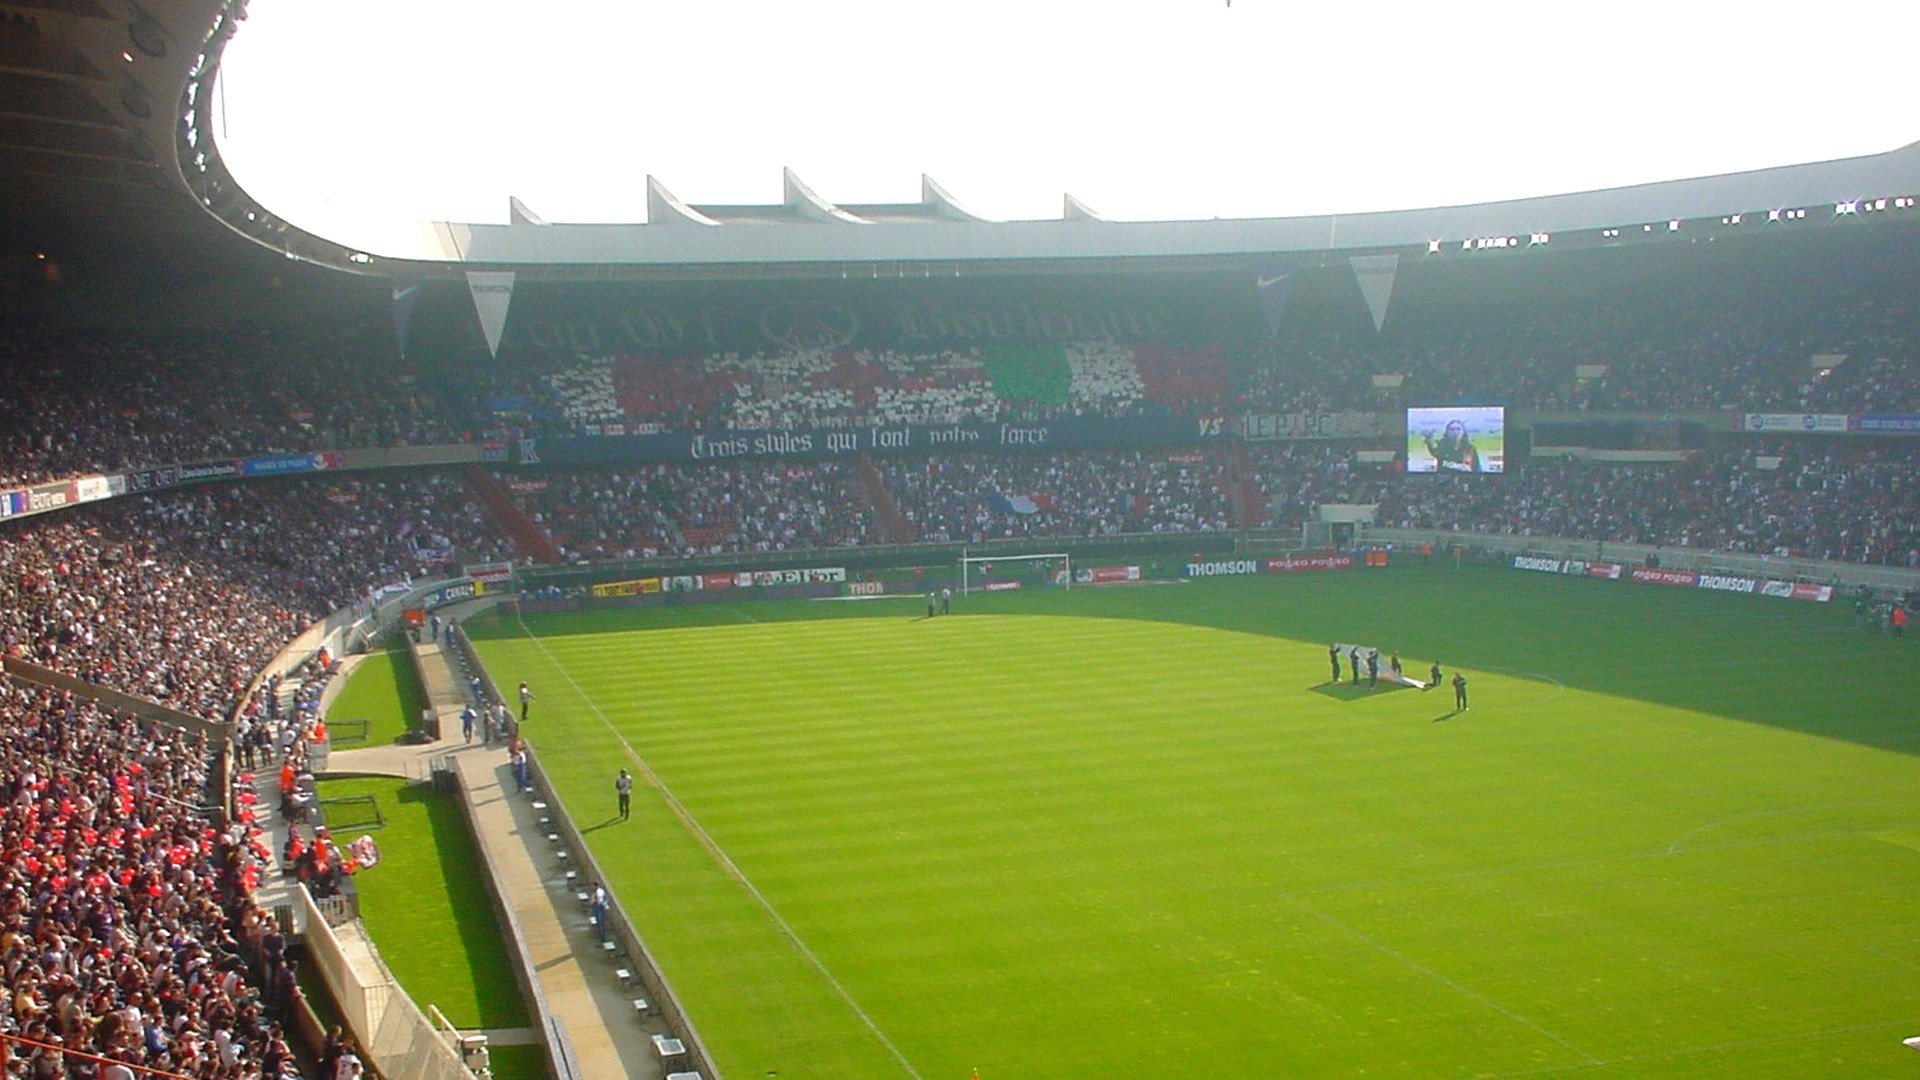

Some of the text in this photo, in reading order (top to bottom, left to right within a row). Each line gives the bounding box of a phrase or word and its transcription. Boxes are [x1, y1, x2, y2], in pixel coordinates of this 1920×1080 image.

[690, 434, 748, 459] Trois
[754, 431, 813, 455] styles
[826, 430, 857, 453] qui
[1000, 422, 1048, 444] force
[1187, 560, 1257, 576] THOMSON
[1514, 556, 1560, 573] THOMSON
[1698, 575, 1756, 593] THOMSON
